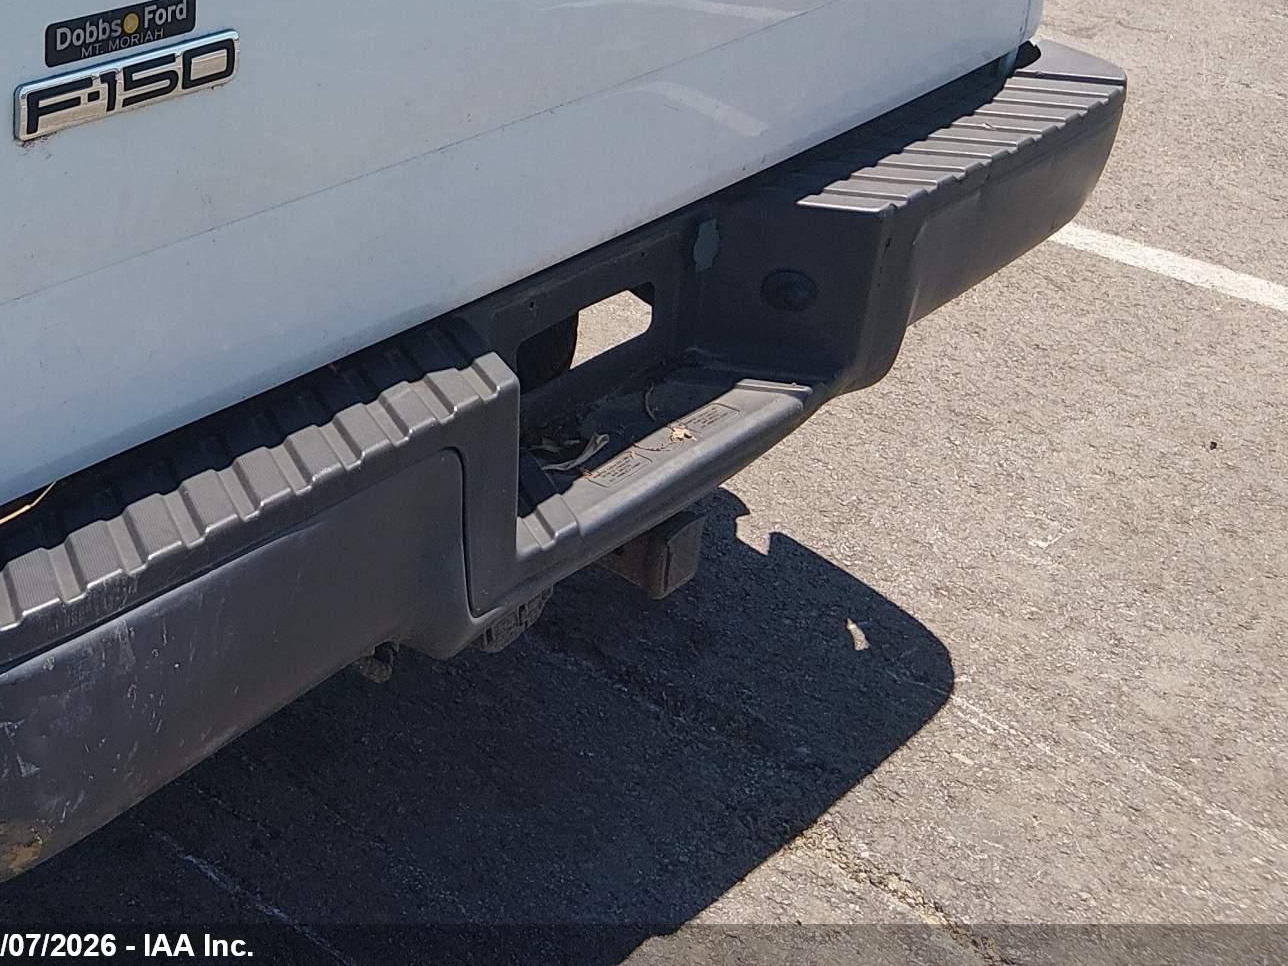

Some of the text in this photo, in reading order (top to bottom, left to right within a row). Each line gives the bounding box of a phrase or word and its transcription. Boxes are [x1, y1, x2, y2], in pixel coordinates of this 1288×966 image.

[55, 18, 122, 51] Dobbs
[80, 27, 165, 59] MT. MORIAH
[25, 37, 237, 136] F-150
